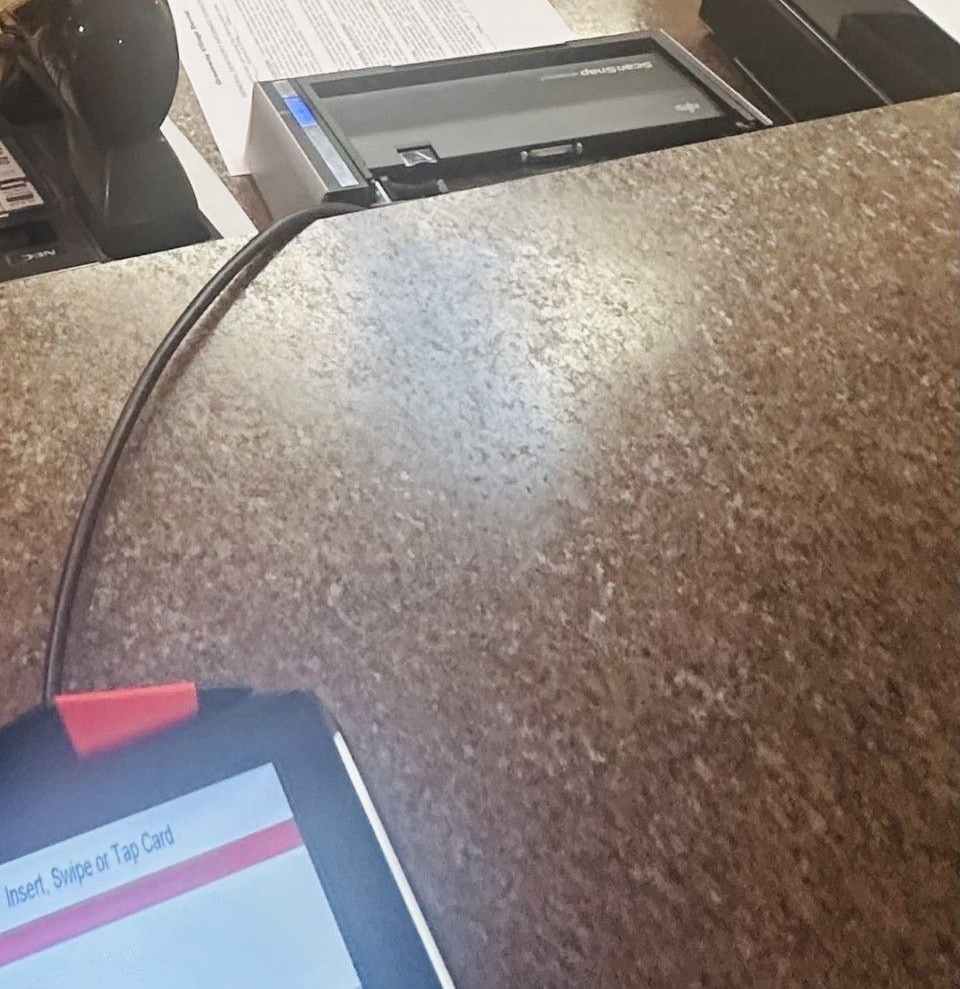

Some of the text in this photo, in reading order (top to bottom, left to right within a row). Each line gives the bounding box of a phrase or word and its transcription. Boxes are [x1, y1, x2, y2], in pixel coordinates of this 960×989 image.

[580, 61, 653, 77] ScanSnap
[20, 249, 56, 261] NEC
[4, 824, 176, 908] Insert, Swipe or Tap Card
